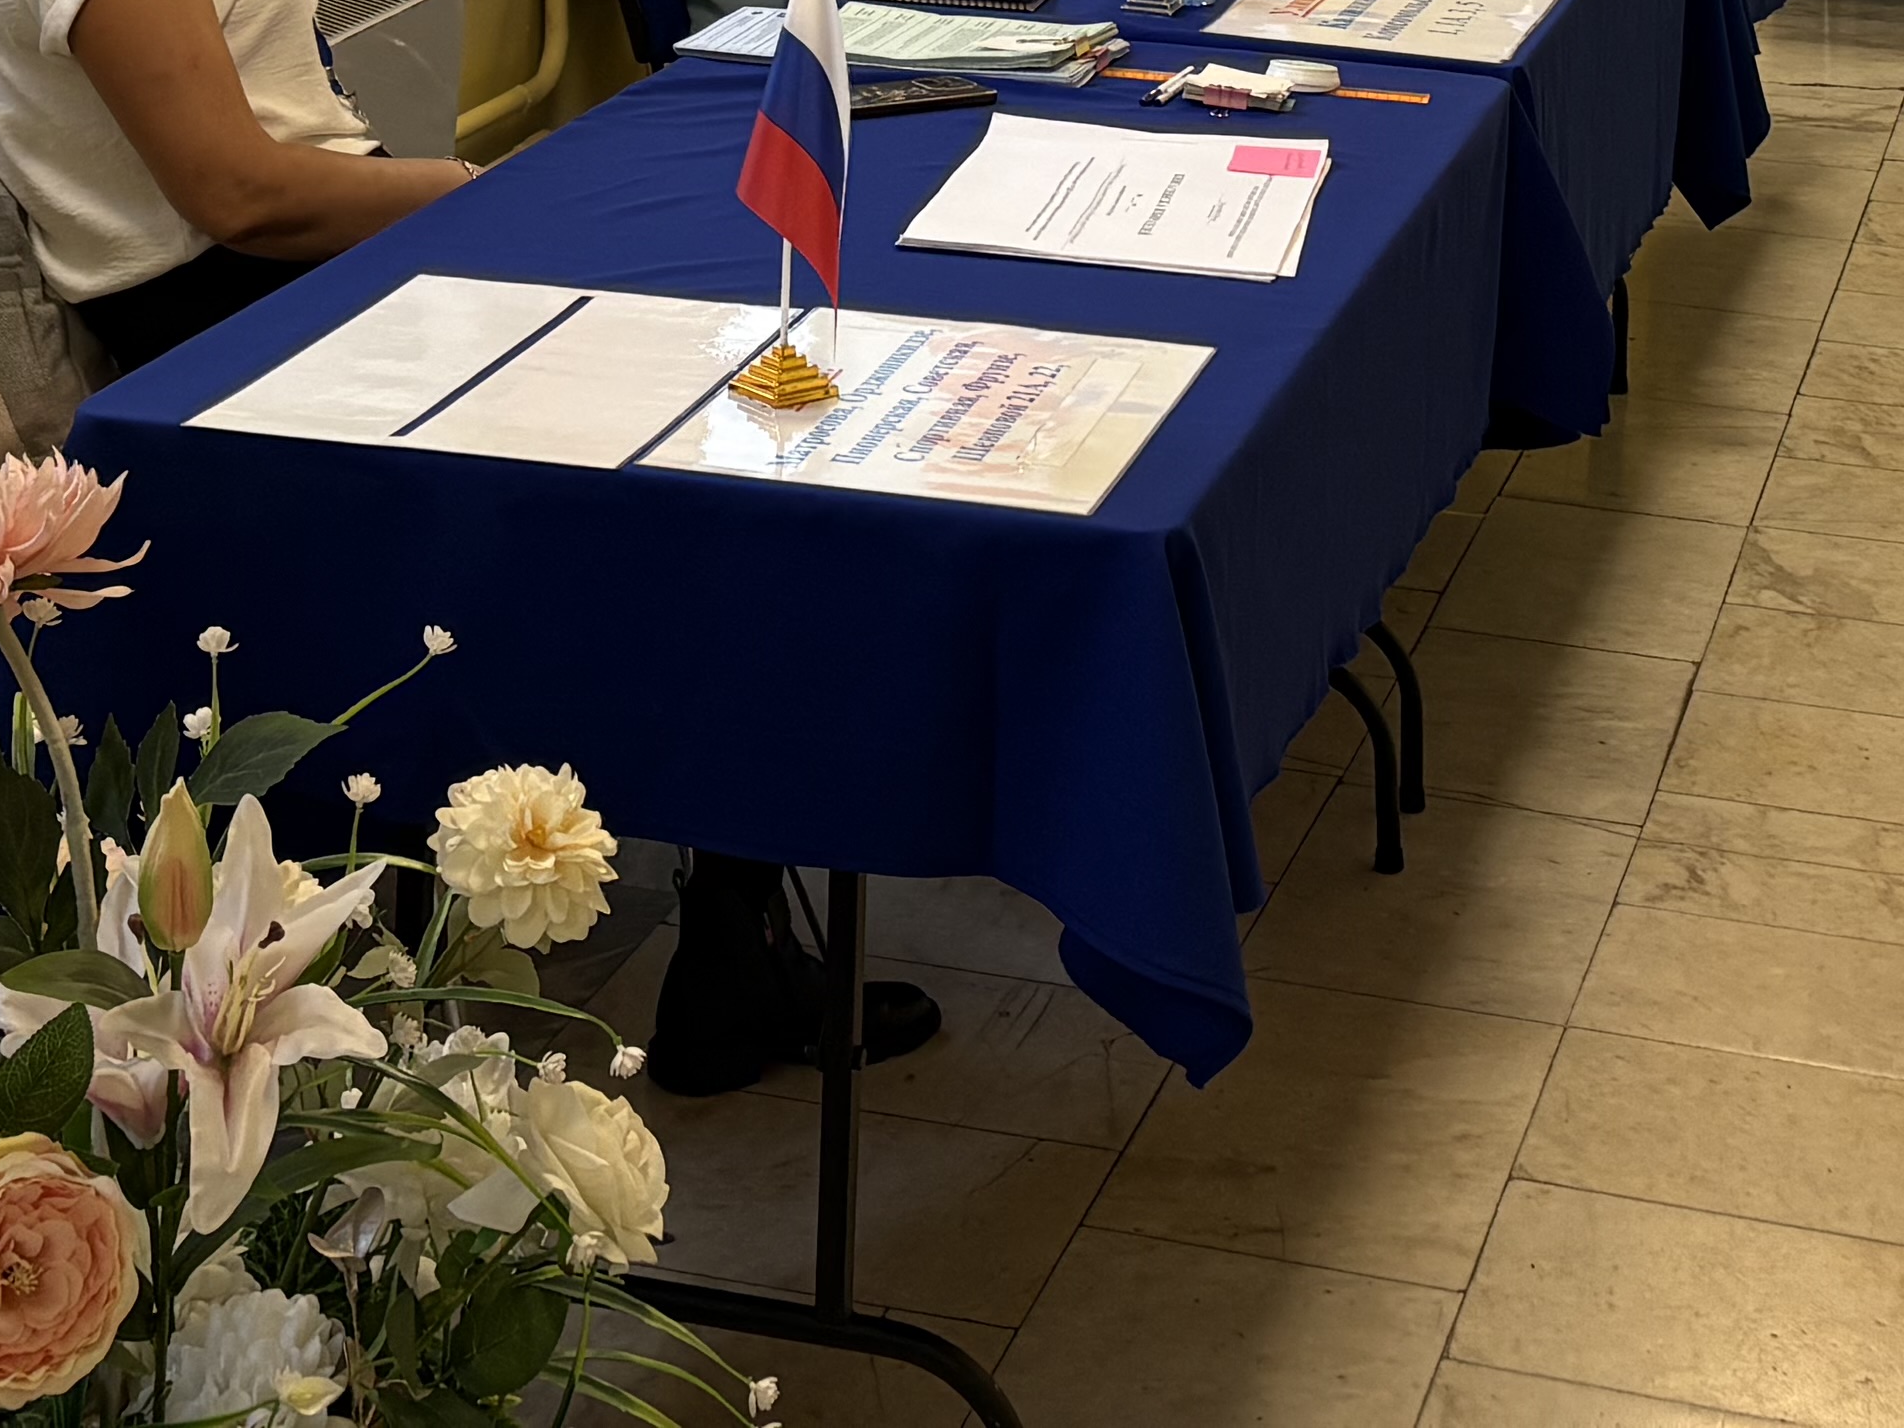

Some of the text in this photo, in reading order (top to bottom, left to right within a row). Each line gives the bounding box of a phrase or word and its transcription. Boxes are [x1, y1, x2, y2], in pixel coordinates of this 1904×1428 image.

[830, 397, 929, 465] Пионерская,
[903, 341, 984, 394] Советская,
[894, 394, 988, 462] Спортивная,
